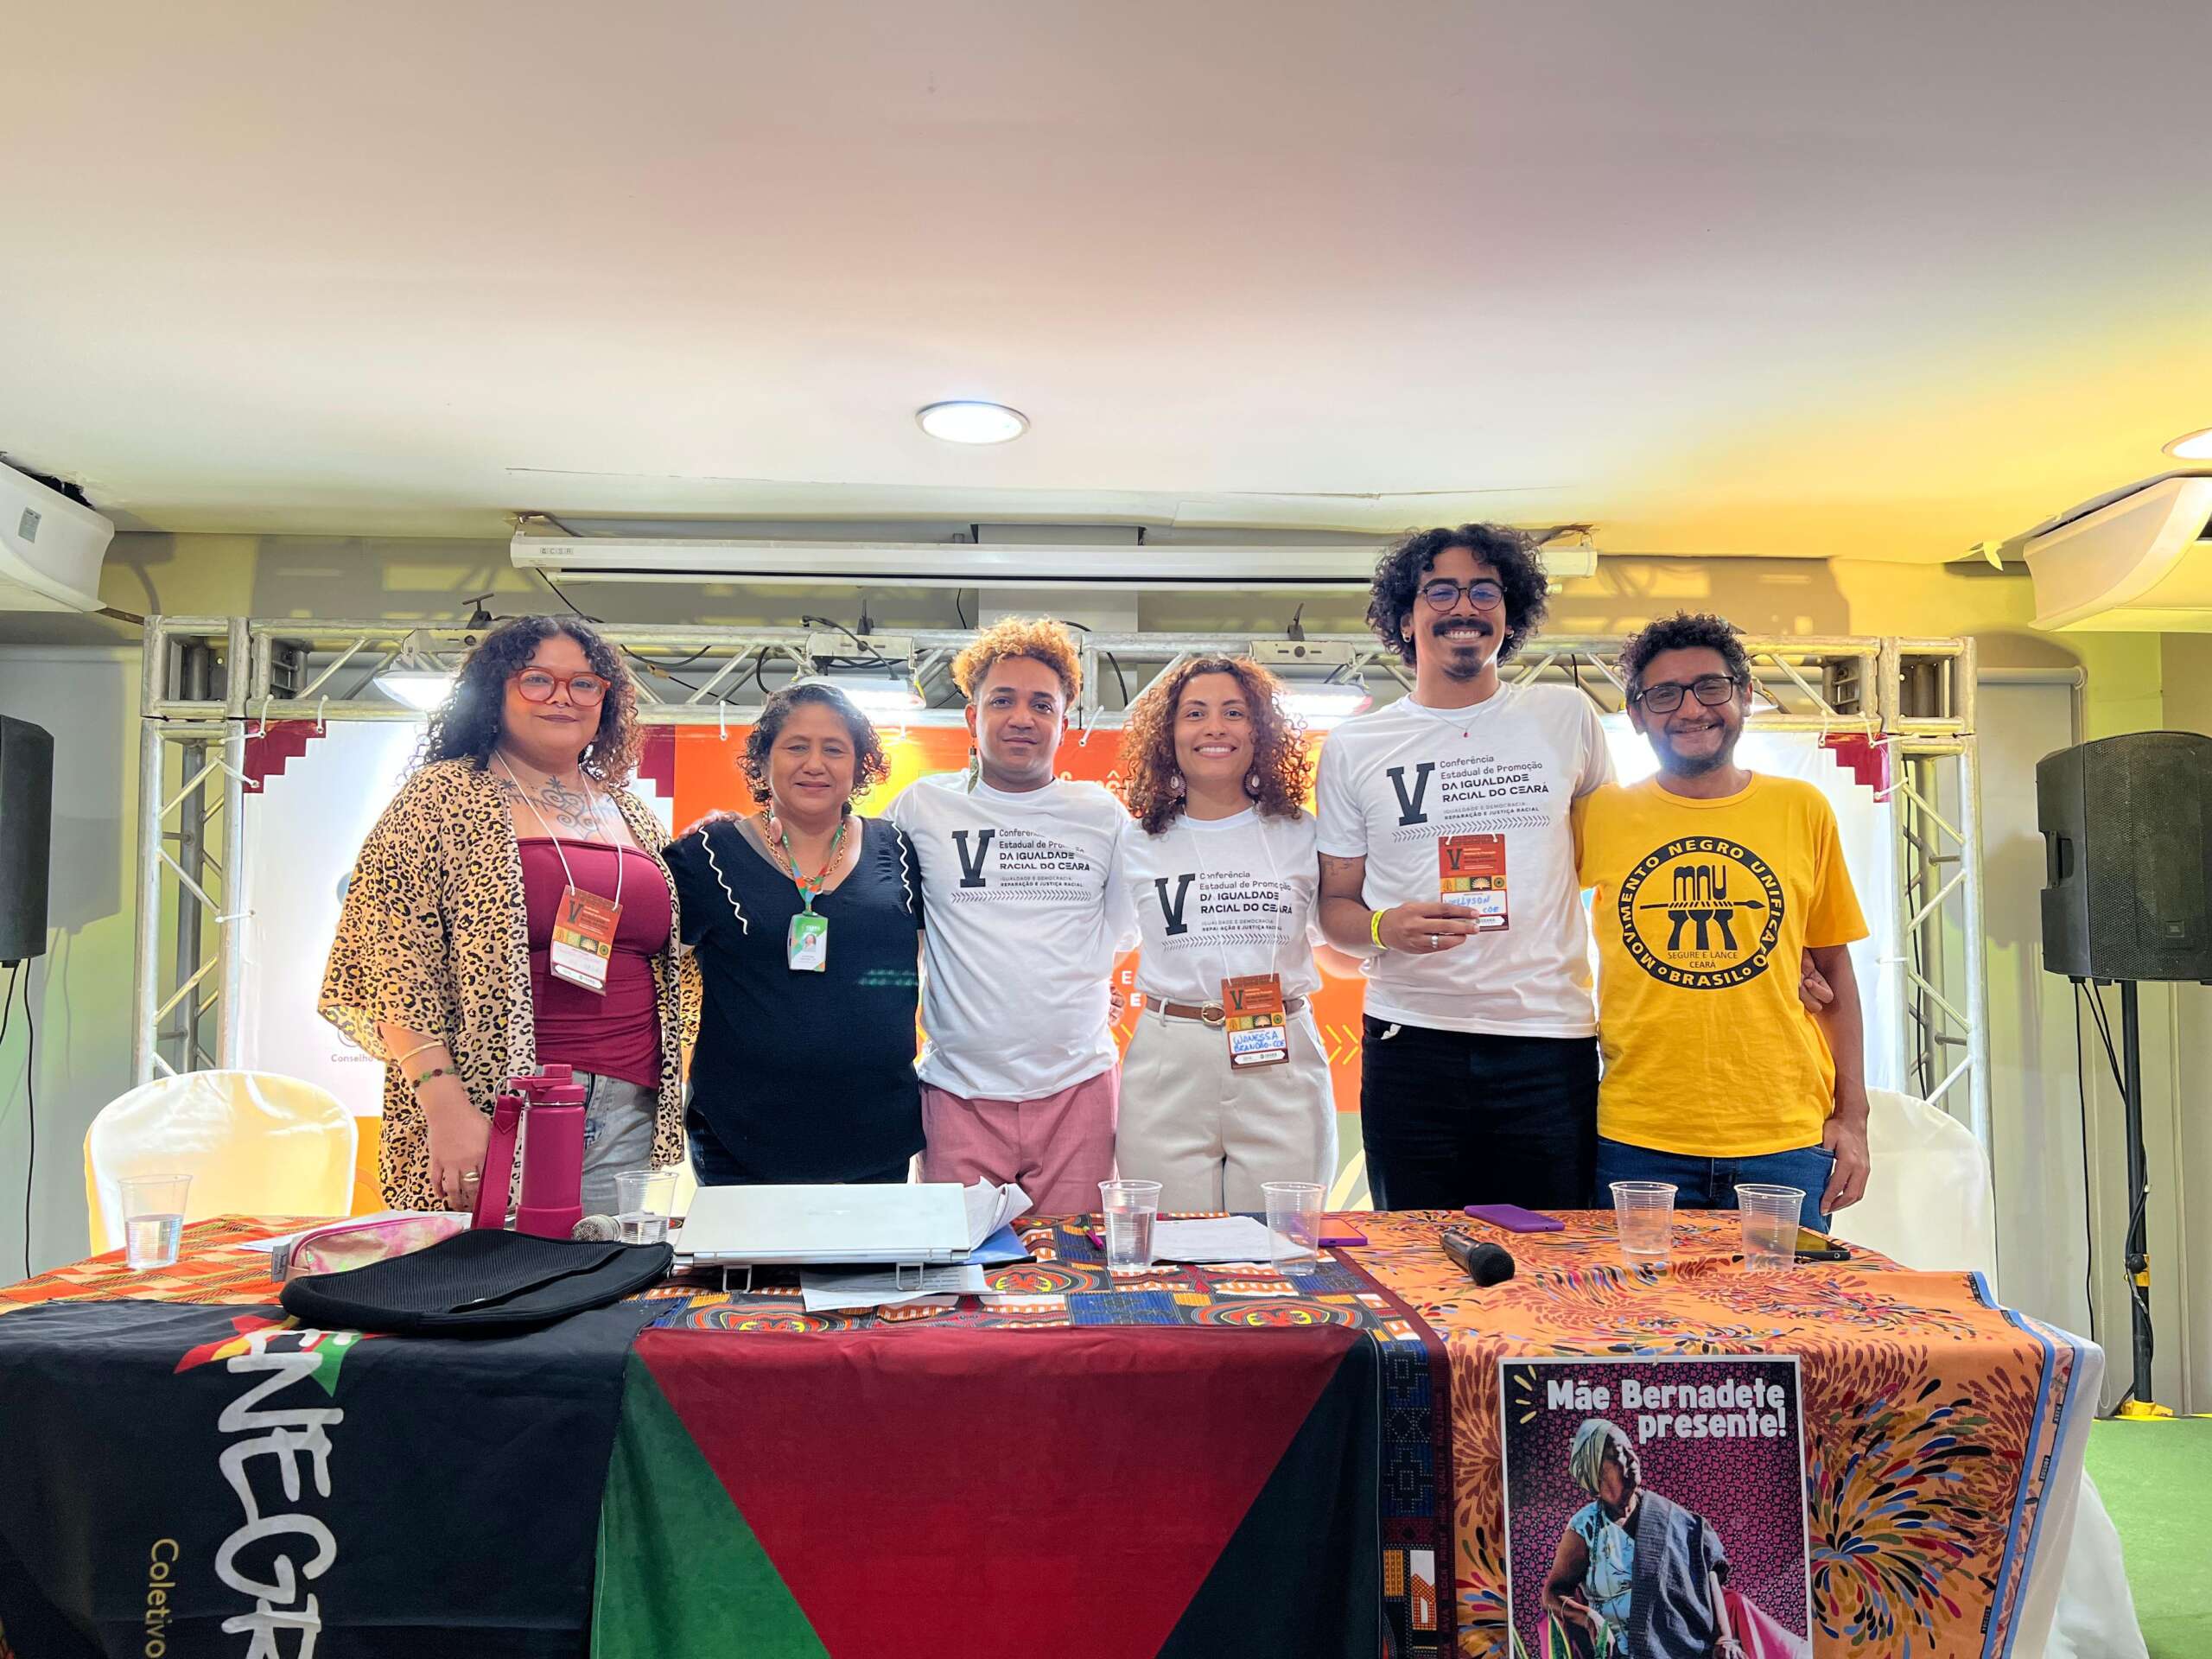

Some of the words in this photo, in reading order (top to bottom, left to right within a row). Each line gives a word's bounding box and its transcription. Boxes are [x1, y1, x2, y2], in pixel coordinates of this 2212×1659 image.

[1440, 755, 1494, 768] Conferência
[1440, 767, 1480, 779] Estadual
[1497, 761, 1542, 773] Promoção
[1461, 774, 1529, 788] IGUALDADE
[1386, 762, 1435, 826] V
[1442, 791, 1486, 802] RACIAL
[1489, 788, 1506, 797] DO
[1510, 782, 1549, 795] CEARÁ
[1036, 840, 1046, 849] de
[1669, 840, 1744, 859] NEGRO
[951, 829, 995, 887] V
[1199, 881, 1236, 890] Estadual
[1154, 873, 1196, 936] V
[1217, 892, 1279, 900] IGUALDADE
[1201, 905, 1240, 913] RACIAL
[1243, 903, 1259, 912] DO
[1621, 856, 1660, 970] MOVIMENTO
[1669, 970, 1744, 987] BRASIL
[331, 1053, 374, 1063] Conselho
[1547, 1378, 1611, 1410] Mãe
[1621, 1378, 1785, 1410] Bernadete
[1638, 1407, 1787, 1445] presente!
[145, 1538, 180, 1658] Coletivo
